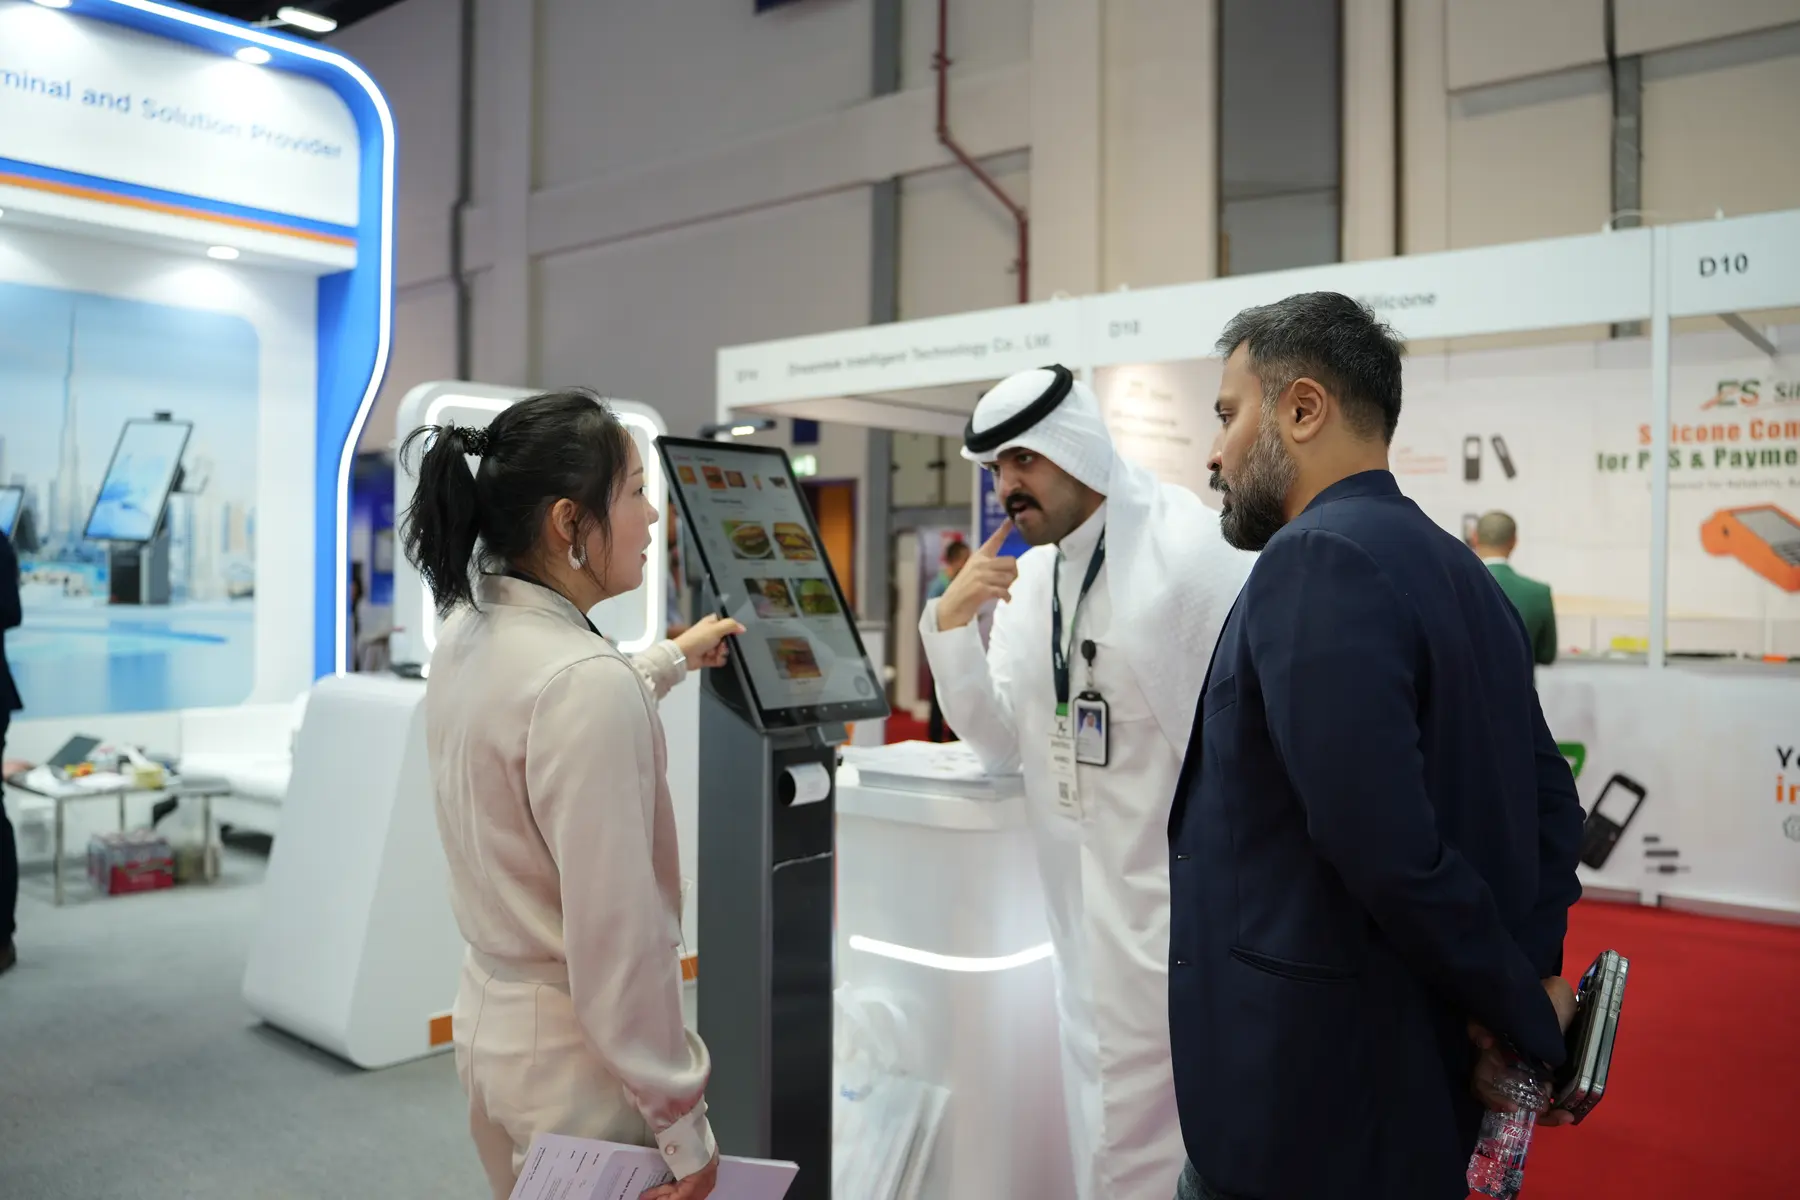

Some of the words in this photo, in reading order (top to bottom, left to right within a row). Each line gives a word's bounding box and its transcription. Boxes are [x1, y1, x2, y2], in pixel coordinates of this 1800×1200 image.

[82, 87, 131, 114] and
[141, 97, 241, 139] Solution
[1699, 253, 1748, 278] D10
[1638, 422, 1741, 445] Sicone
[1637, 449, 1681, 470] PS
[1776, 745, 1800, 769] Y
